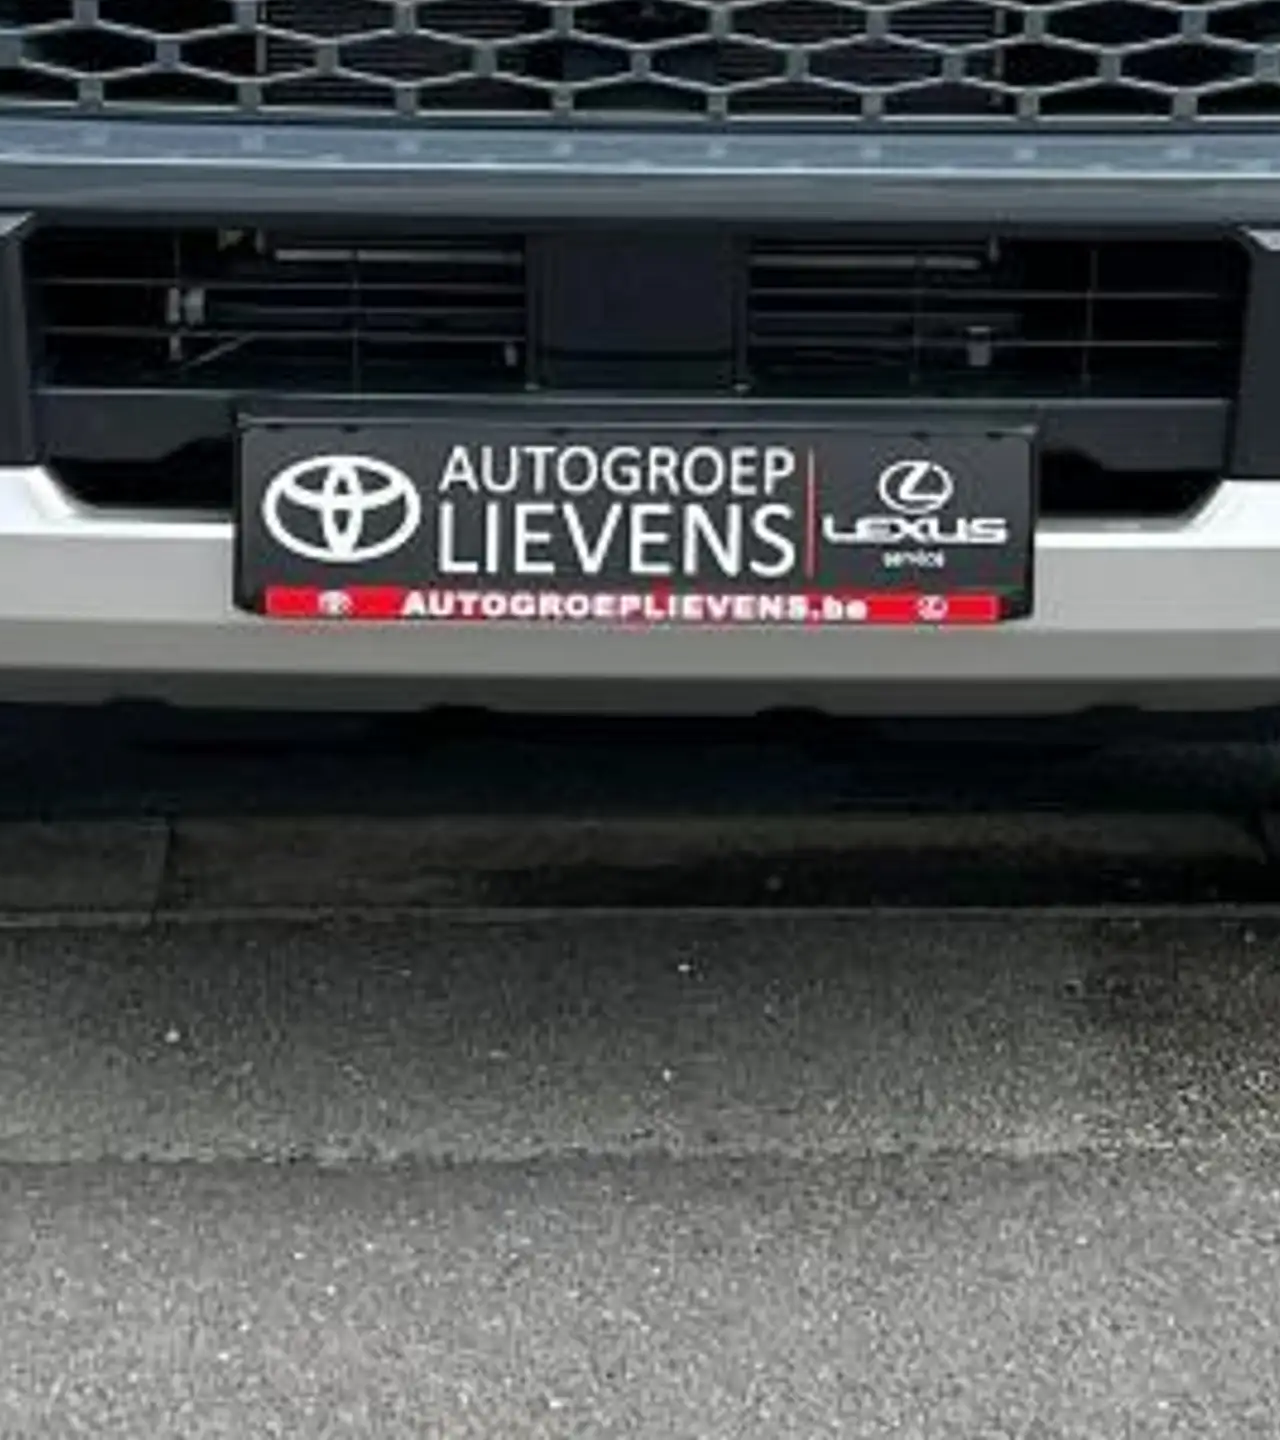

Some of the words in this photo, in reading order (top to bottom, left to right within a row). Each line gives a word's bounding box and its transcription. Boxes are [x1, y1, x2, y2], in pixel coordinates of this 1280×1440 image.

[438, 446, 795, 495] AUTOGROEP
[438, 502, 795, 576] LIEVENS
[822, 515, 1008, 544] LEXUS
[402, 591, 868, 621] AUTOGROEPLIEVENS.be
